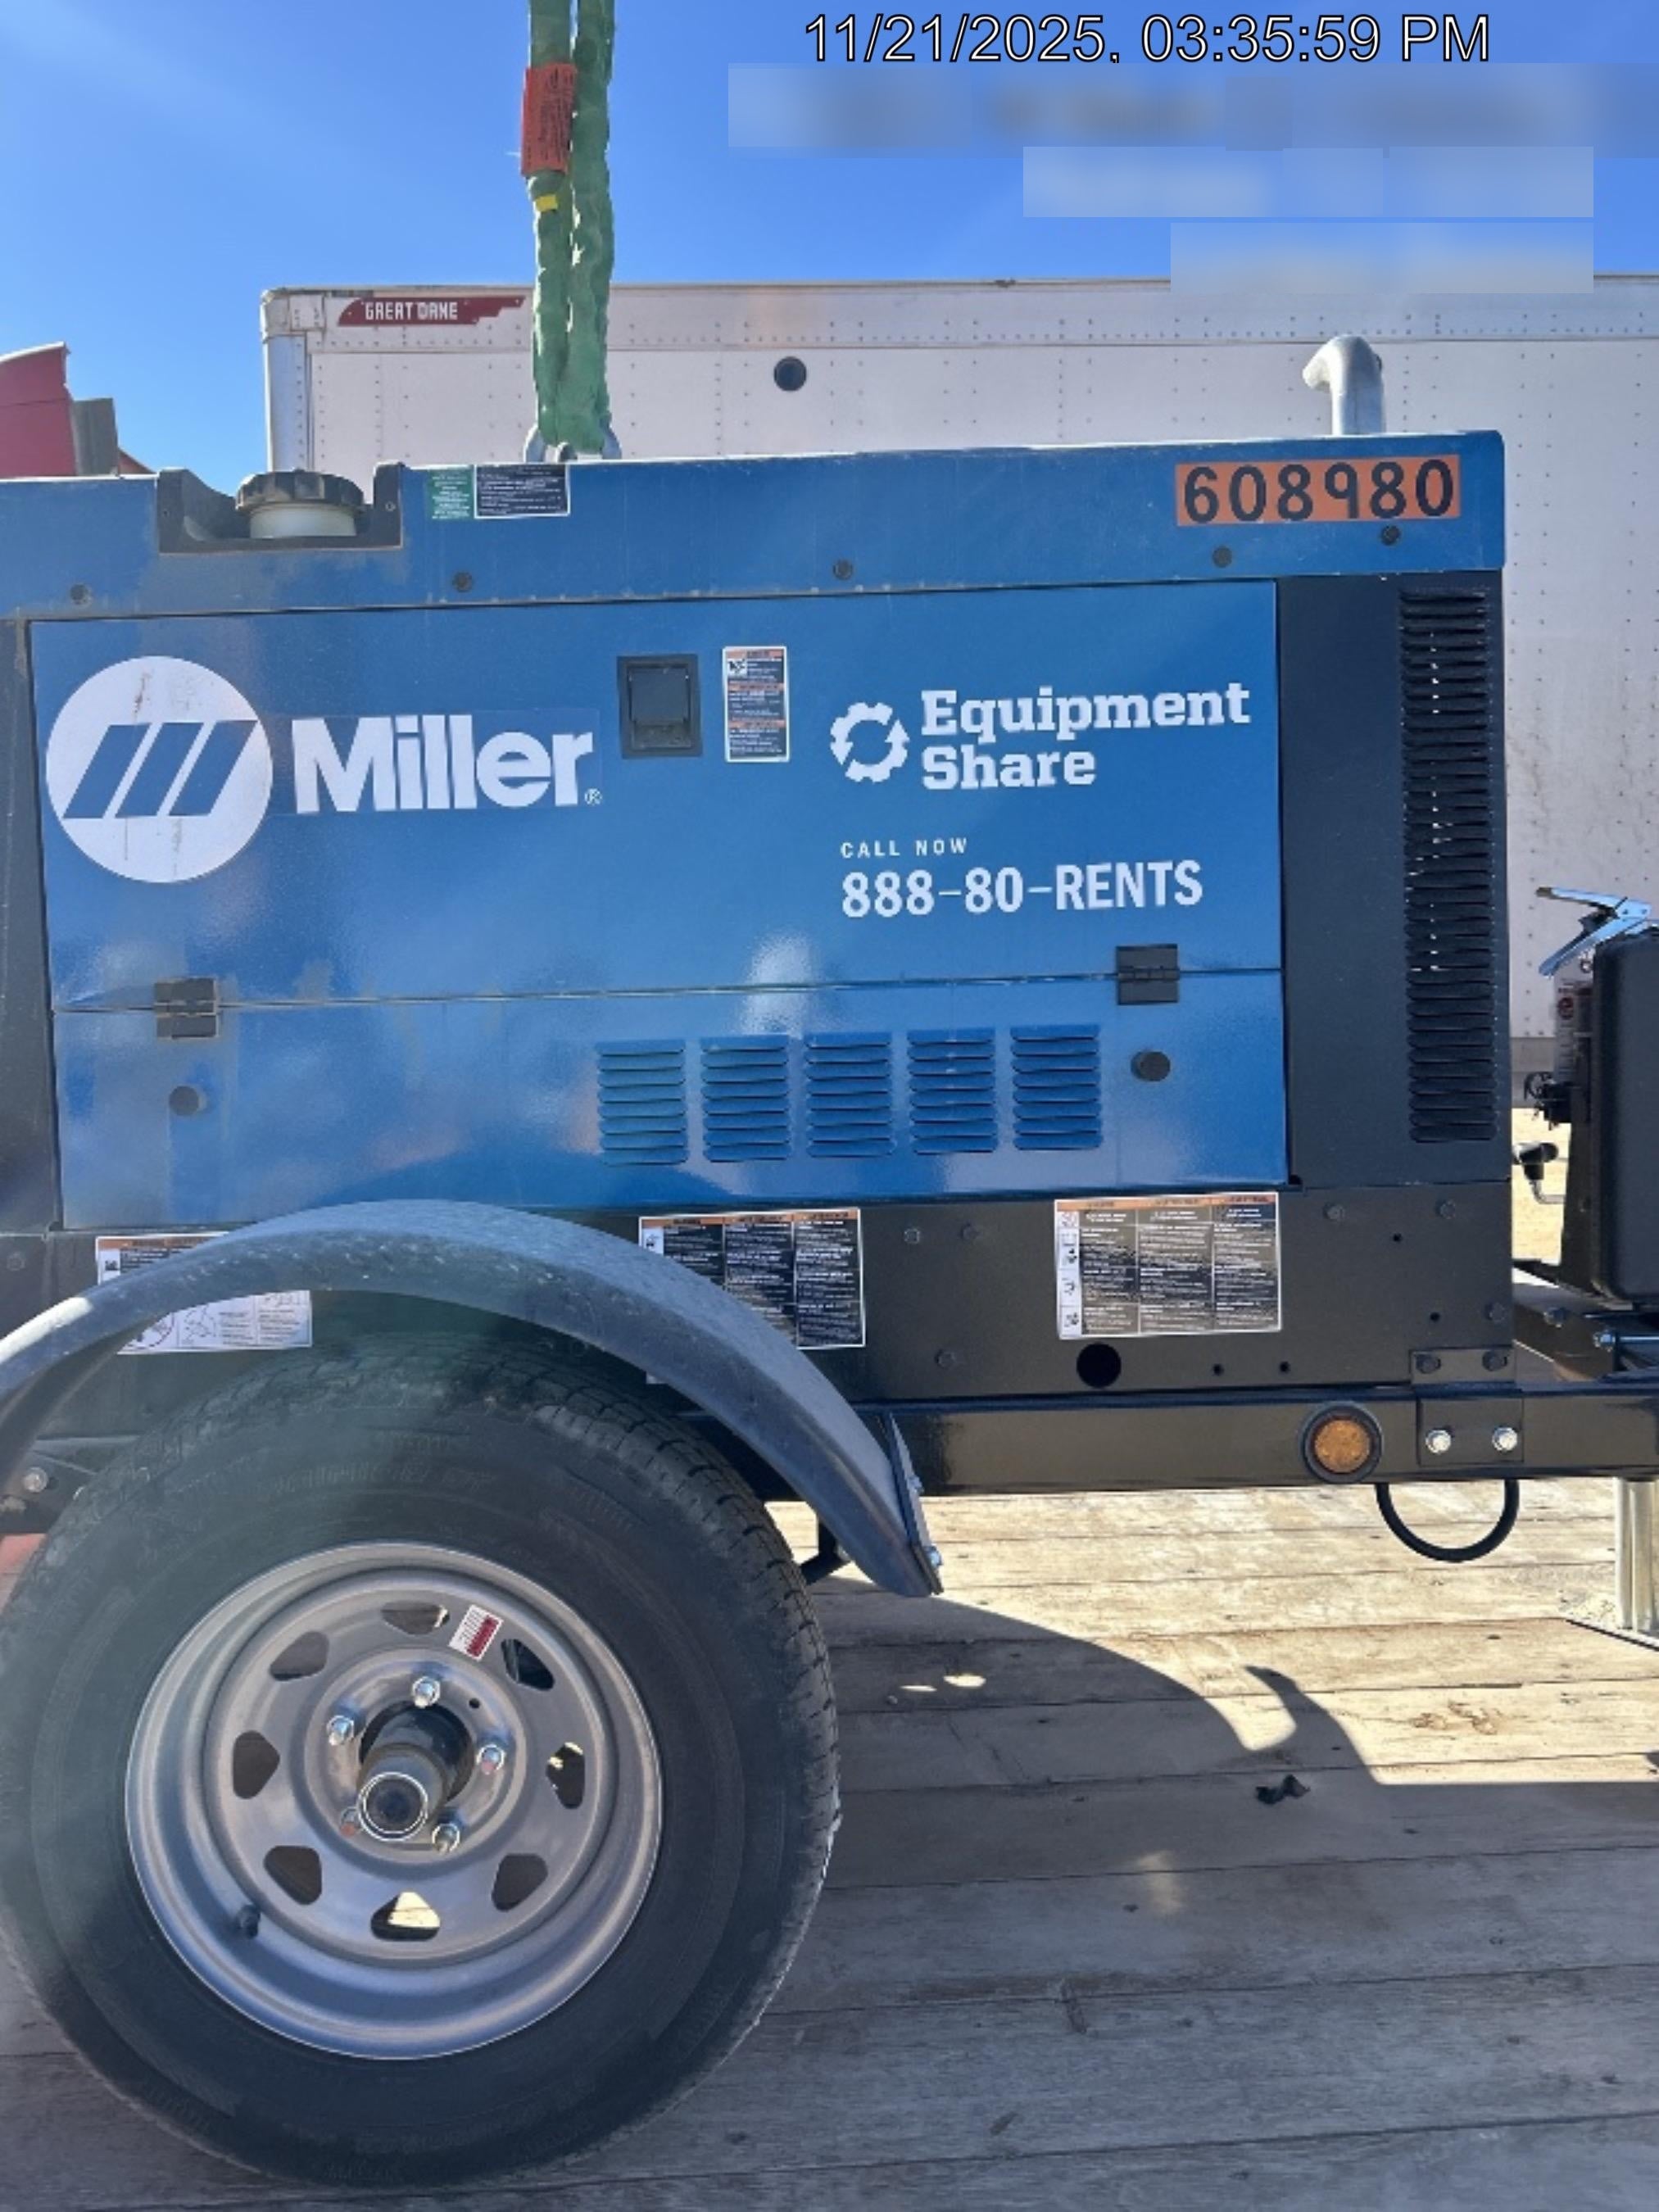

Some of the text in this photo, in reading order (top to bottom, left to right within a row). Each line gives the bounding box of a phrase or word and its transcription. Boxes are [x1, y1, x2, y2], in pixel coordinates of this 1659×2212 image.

[365, 301, 458, 320] GREAT DANE
[1184, 459, 1453, 524] 608980
[921, 682, 1251, 745] Equipment
[292, 714, 594, 814] Miller
[922, 744, 1096, 790] Share
[841, 837, 968, 859] CALL NOW
[841, 859, 1203, 918] 888-80-RENTS
